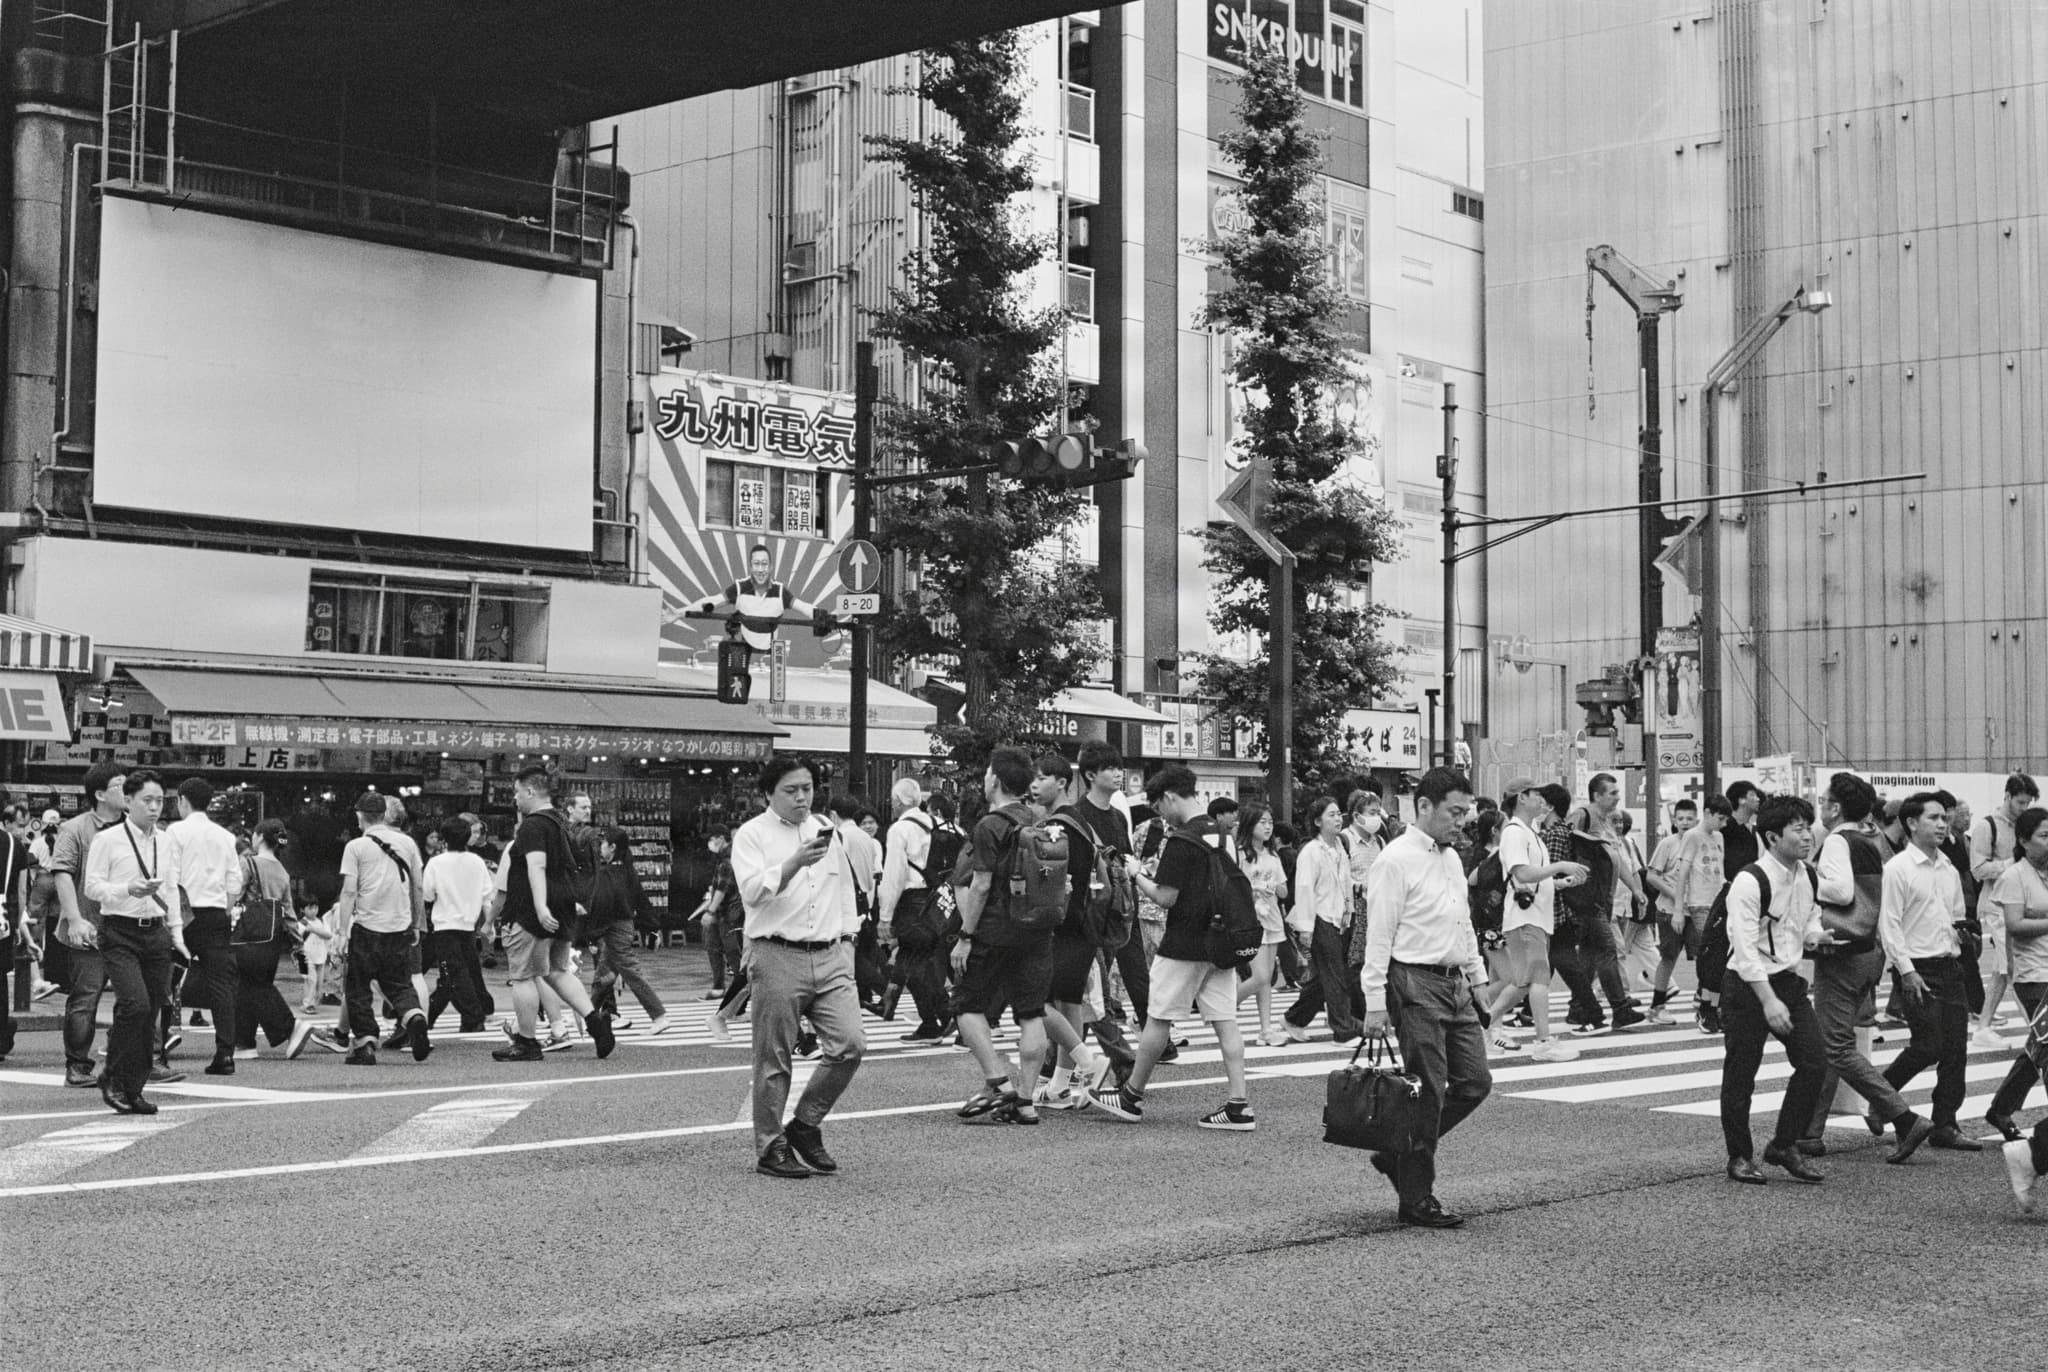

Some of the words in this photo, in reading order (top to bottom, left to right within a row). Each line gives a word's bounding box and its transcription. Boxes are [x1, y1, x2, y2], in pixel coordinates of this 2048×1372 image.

[657, 391, 856, 463] 九州電気
[843, 598, 873, 611] 8-20
[0, 688, 53, 732] E
[755, 703, 879, 723] 九州電気株式社
[1403, 726, 1416, 740] 24
[1870, 775, 1936, 787] imagination
